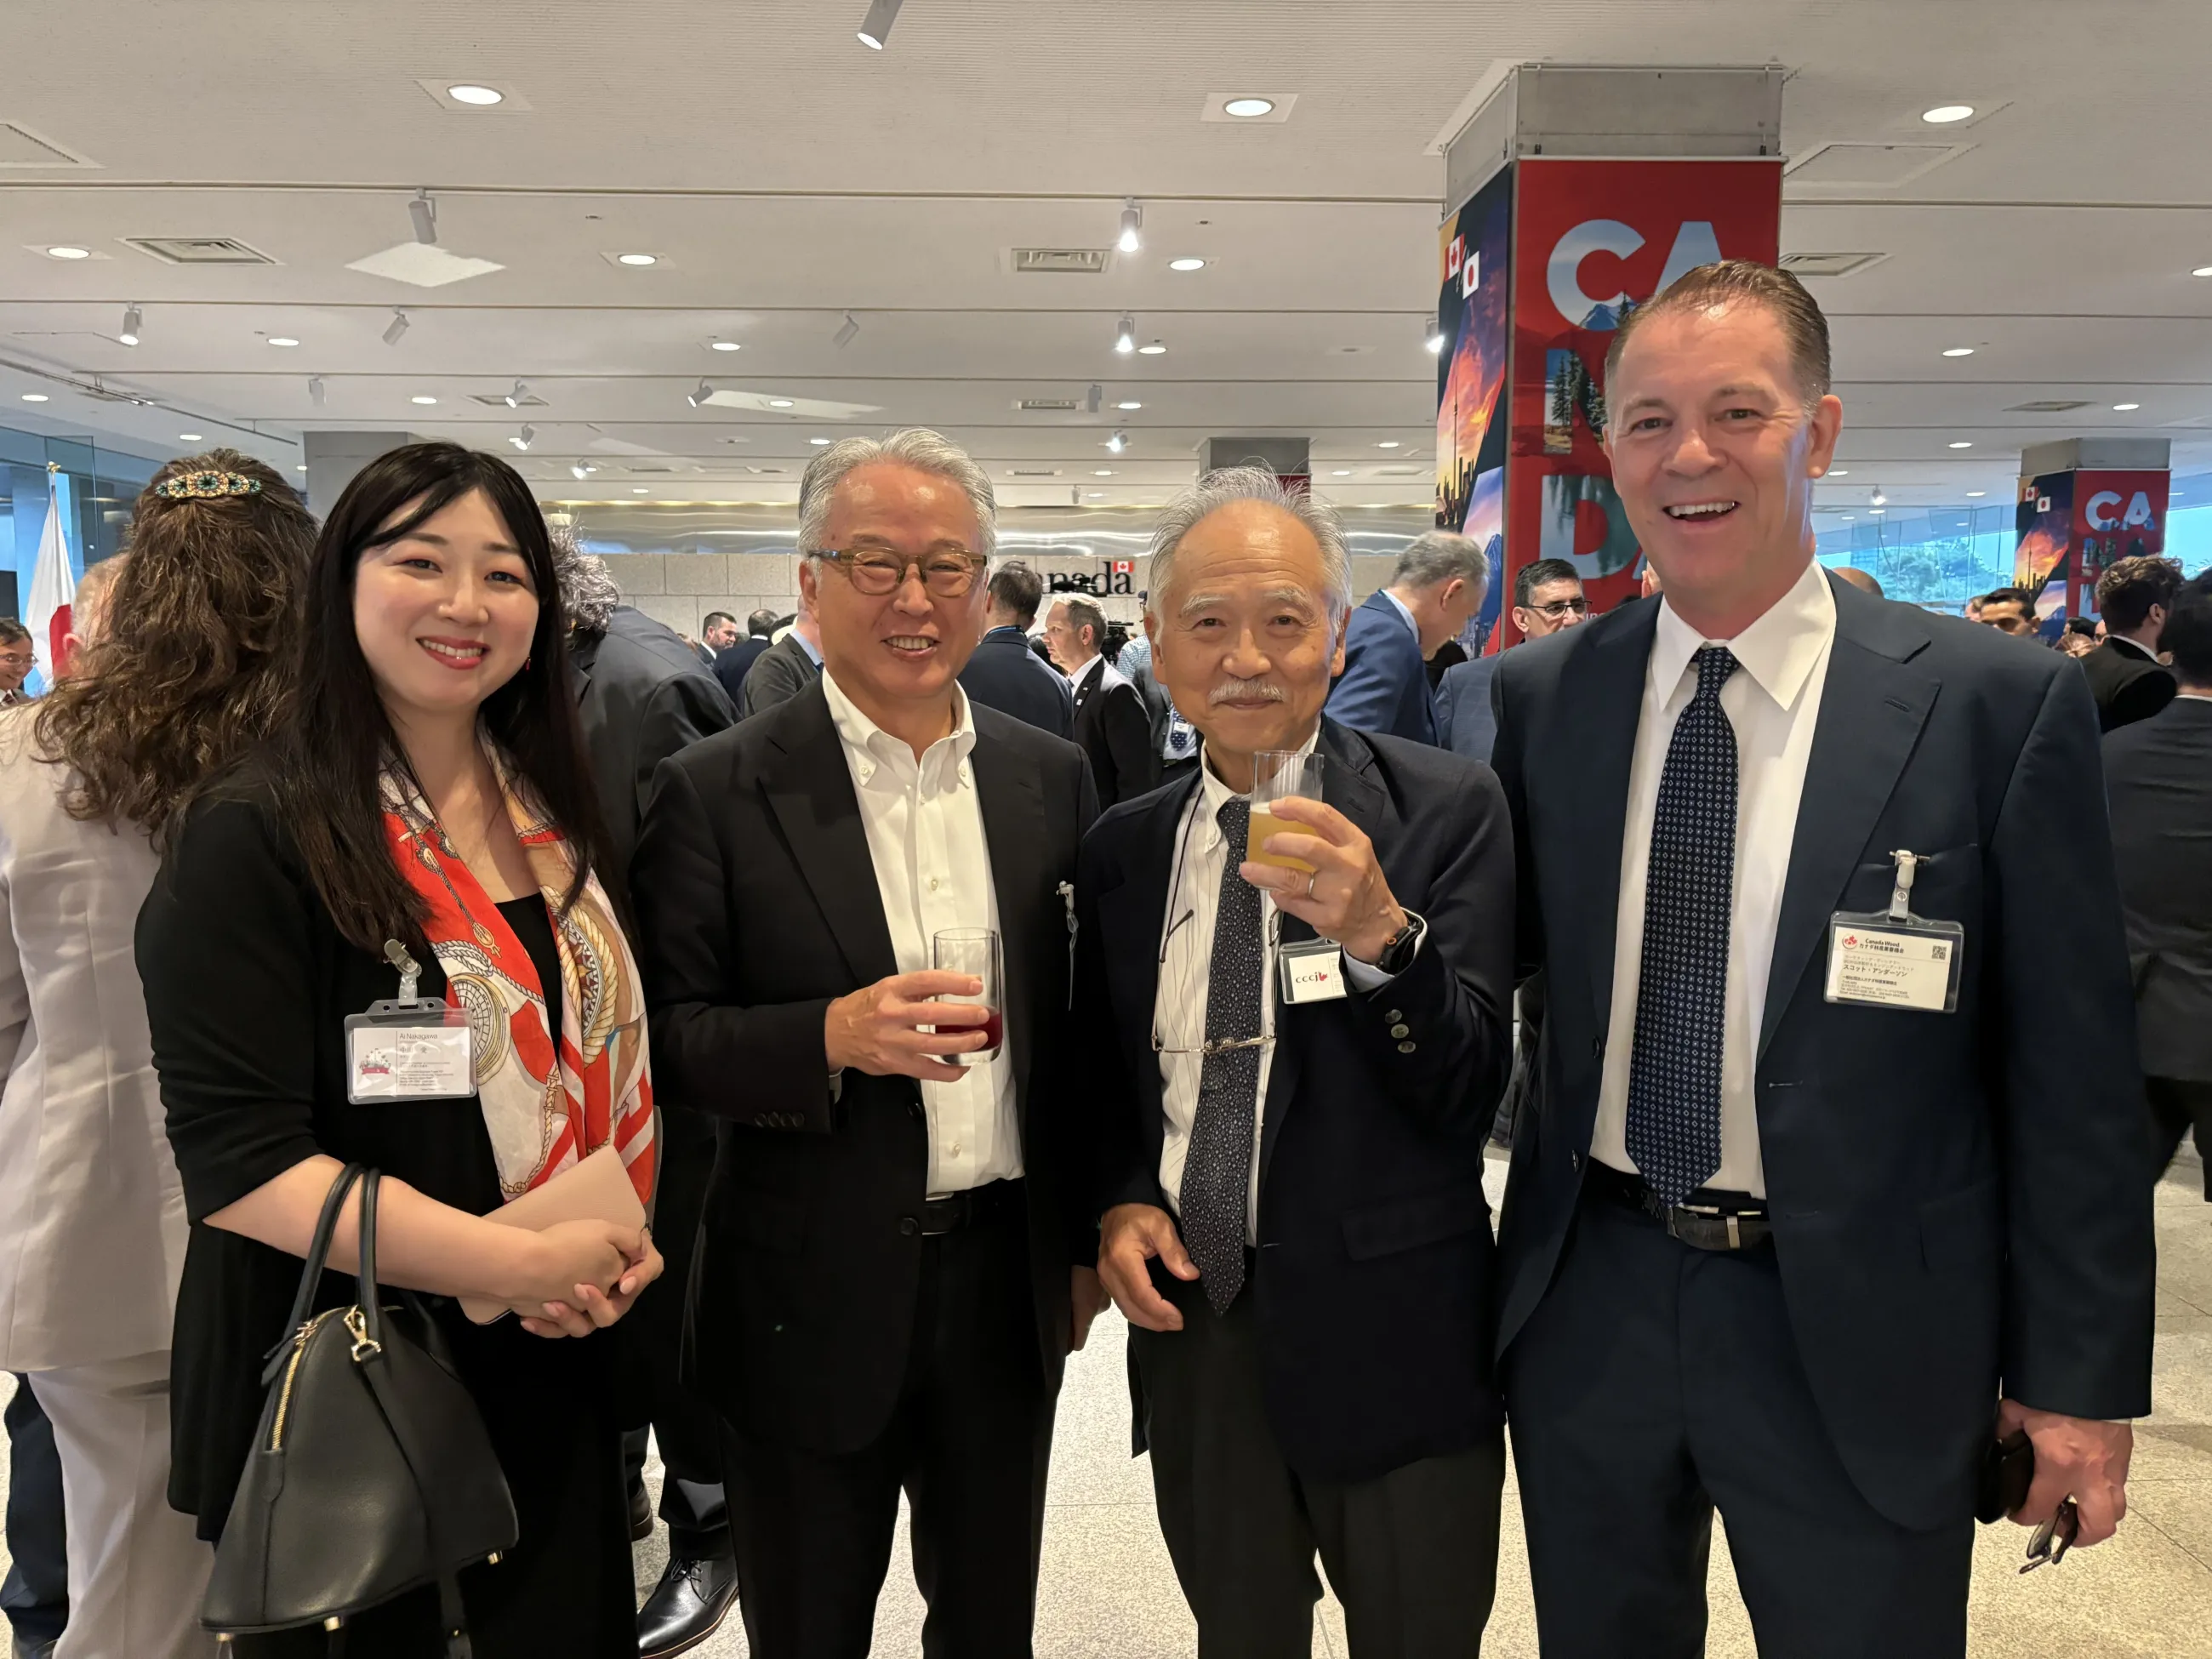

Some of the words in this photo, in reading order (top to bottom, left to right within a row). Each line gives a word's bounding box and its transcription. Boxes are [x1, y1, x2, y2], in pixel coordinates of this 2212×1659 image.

[1539, 475, 1648, 579] D
[2085, 490, 2156, 531] CA
[1005, 561, 1135, 595] nda
